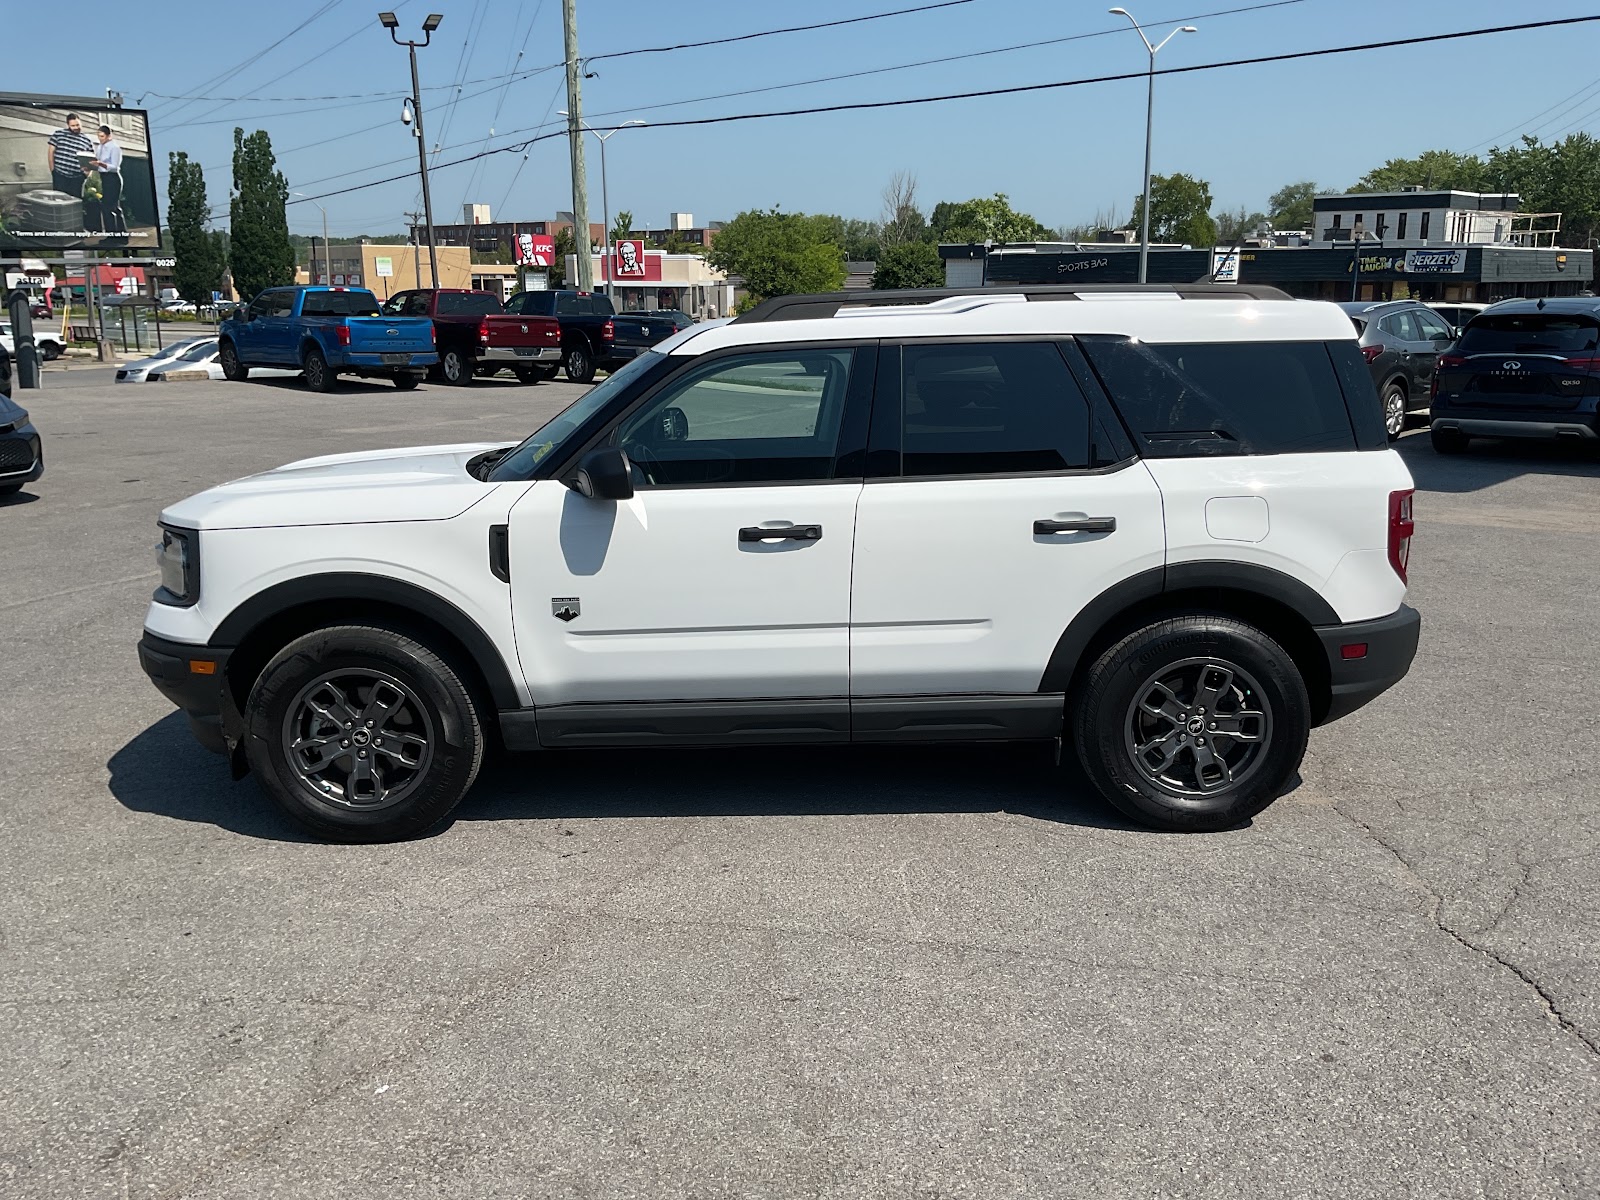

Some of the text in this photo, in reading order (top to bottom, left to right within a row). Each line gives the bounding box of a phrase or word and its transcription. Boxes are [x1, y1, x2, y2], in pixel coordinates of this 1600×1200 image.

[535, 244, 553, 253] KFC
[1361, 256, 1378, 264] TIME
[1409, 254, 1461, 266] JERZEYS
[1057, 258, 1108, 274] SPORTS BAR
[1360, 262, 1388, 273] LAUGH
[17, 276, 46, 285] astral
